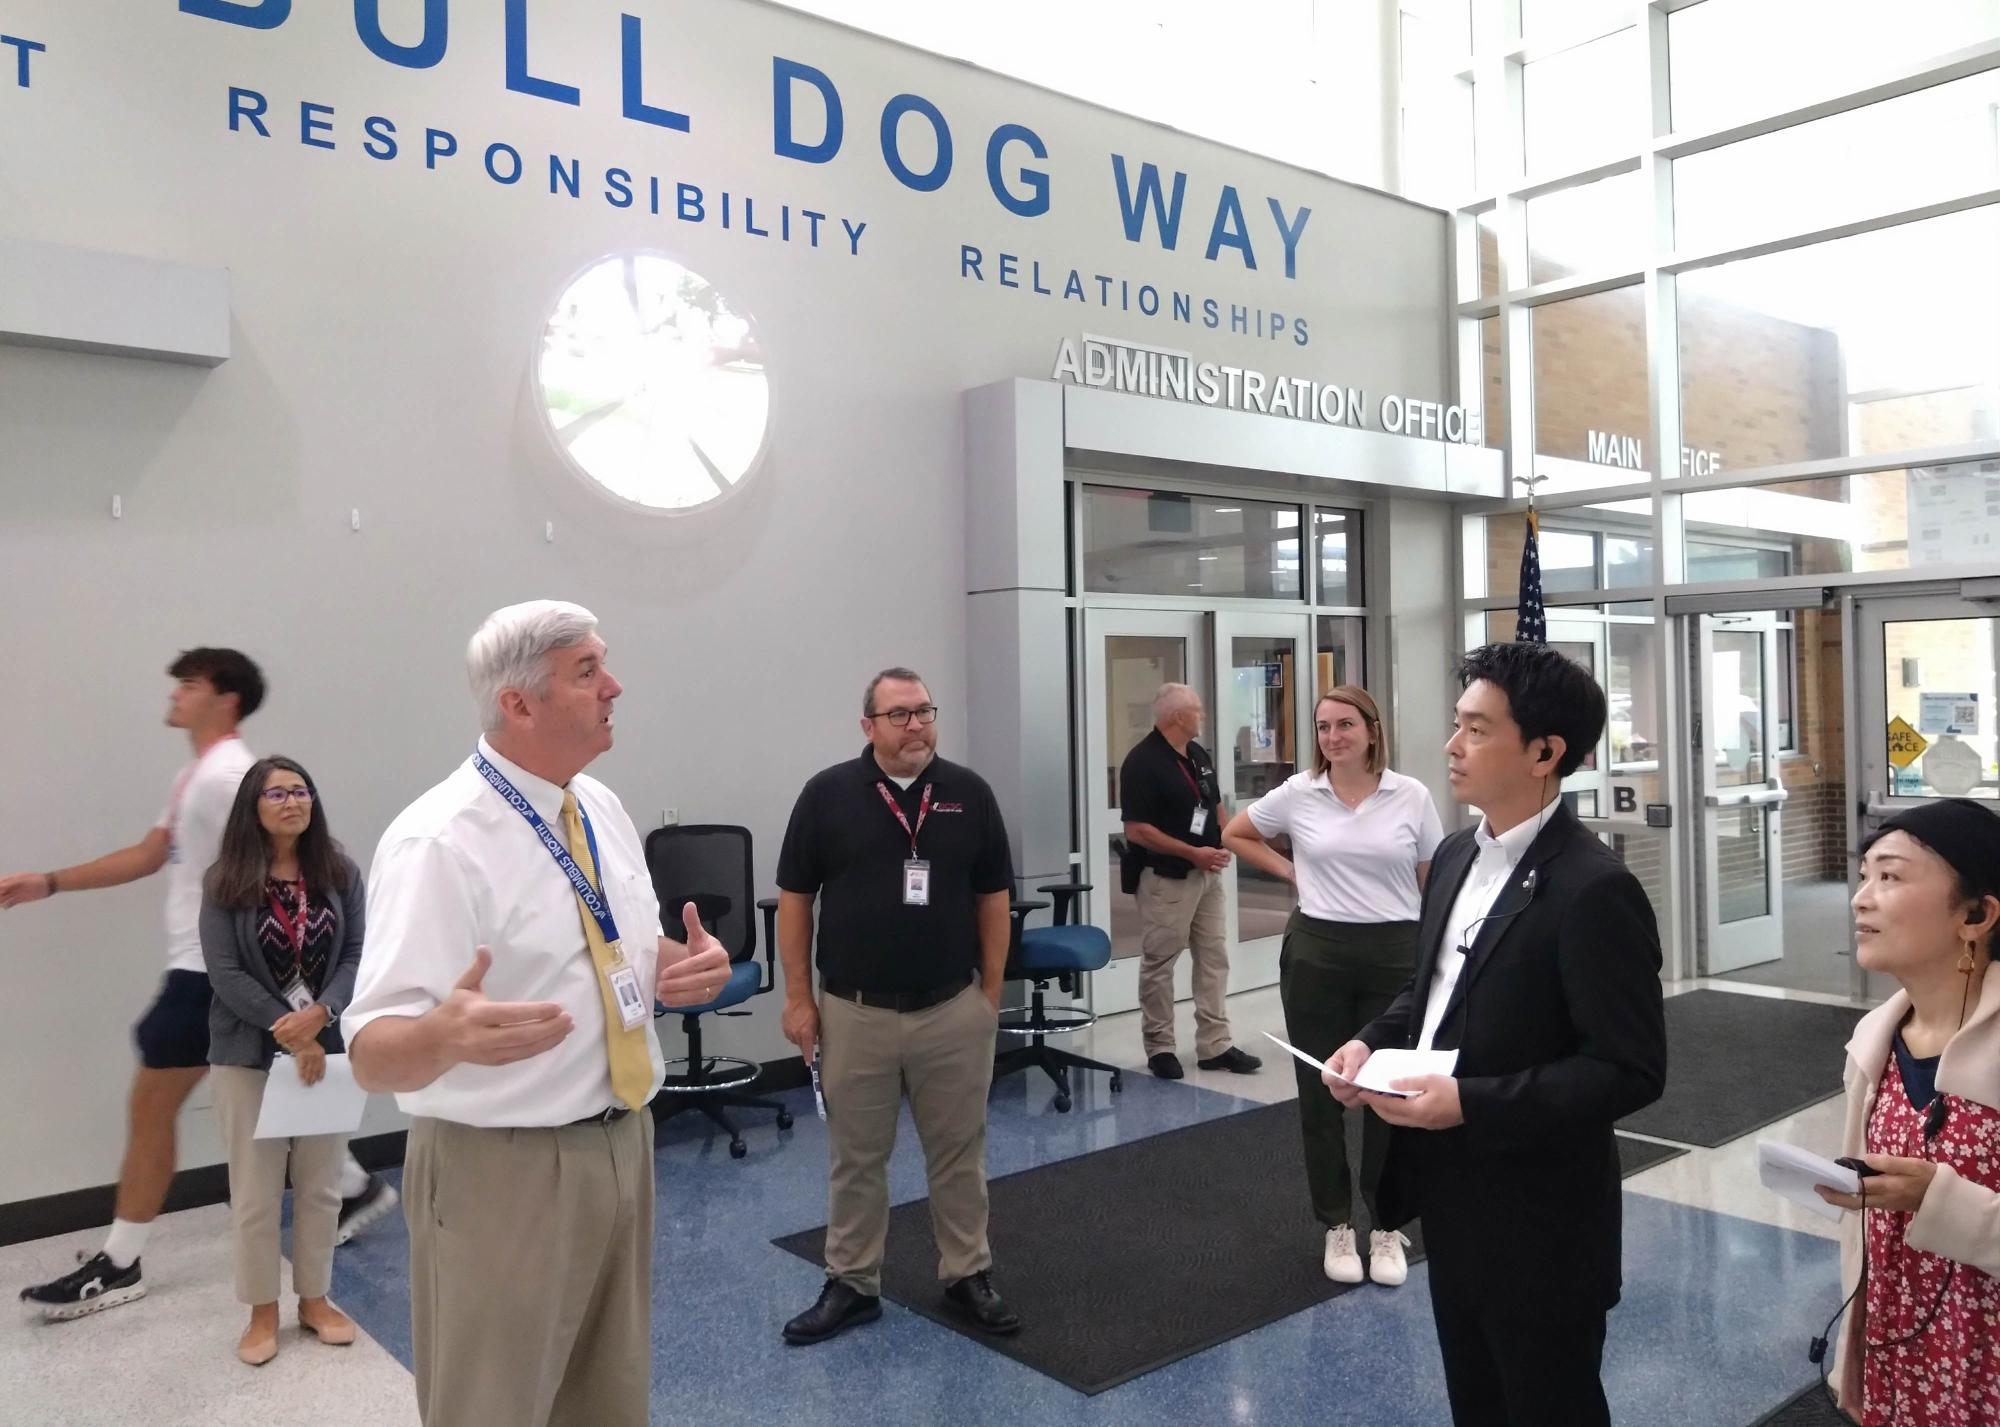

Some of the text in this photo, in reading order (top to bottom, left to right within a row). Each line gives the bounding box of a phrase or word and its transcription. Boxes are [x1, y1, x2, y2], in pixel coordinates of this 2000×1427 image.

[178, 0, 1311, 280] ULL DOG WAY
[228, 86, 867, 256] RESPONSIBILITY
[961, 245, 1309, 346] RELATIONSHIPS
[1052, 336, 1480, 445] ADMINISTRATION OFFICE
[1588, 430, 1721, 477] MAIN FICE
[480, 763, 528, 811] COLUMBUS
[1613, 786, 1637, 812] B
[535, 823, 601, 911] COLUMBUS NORTH
